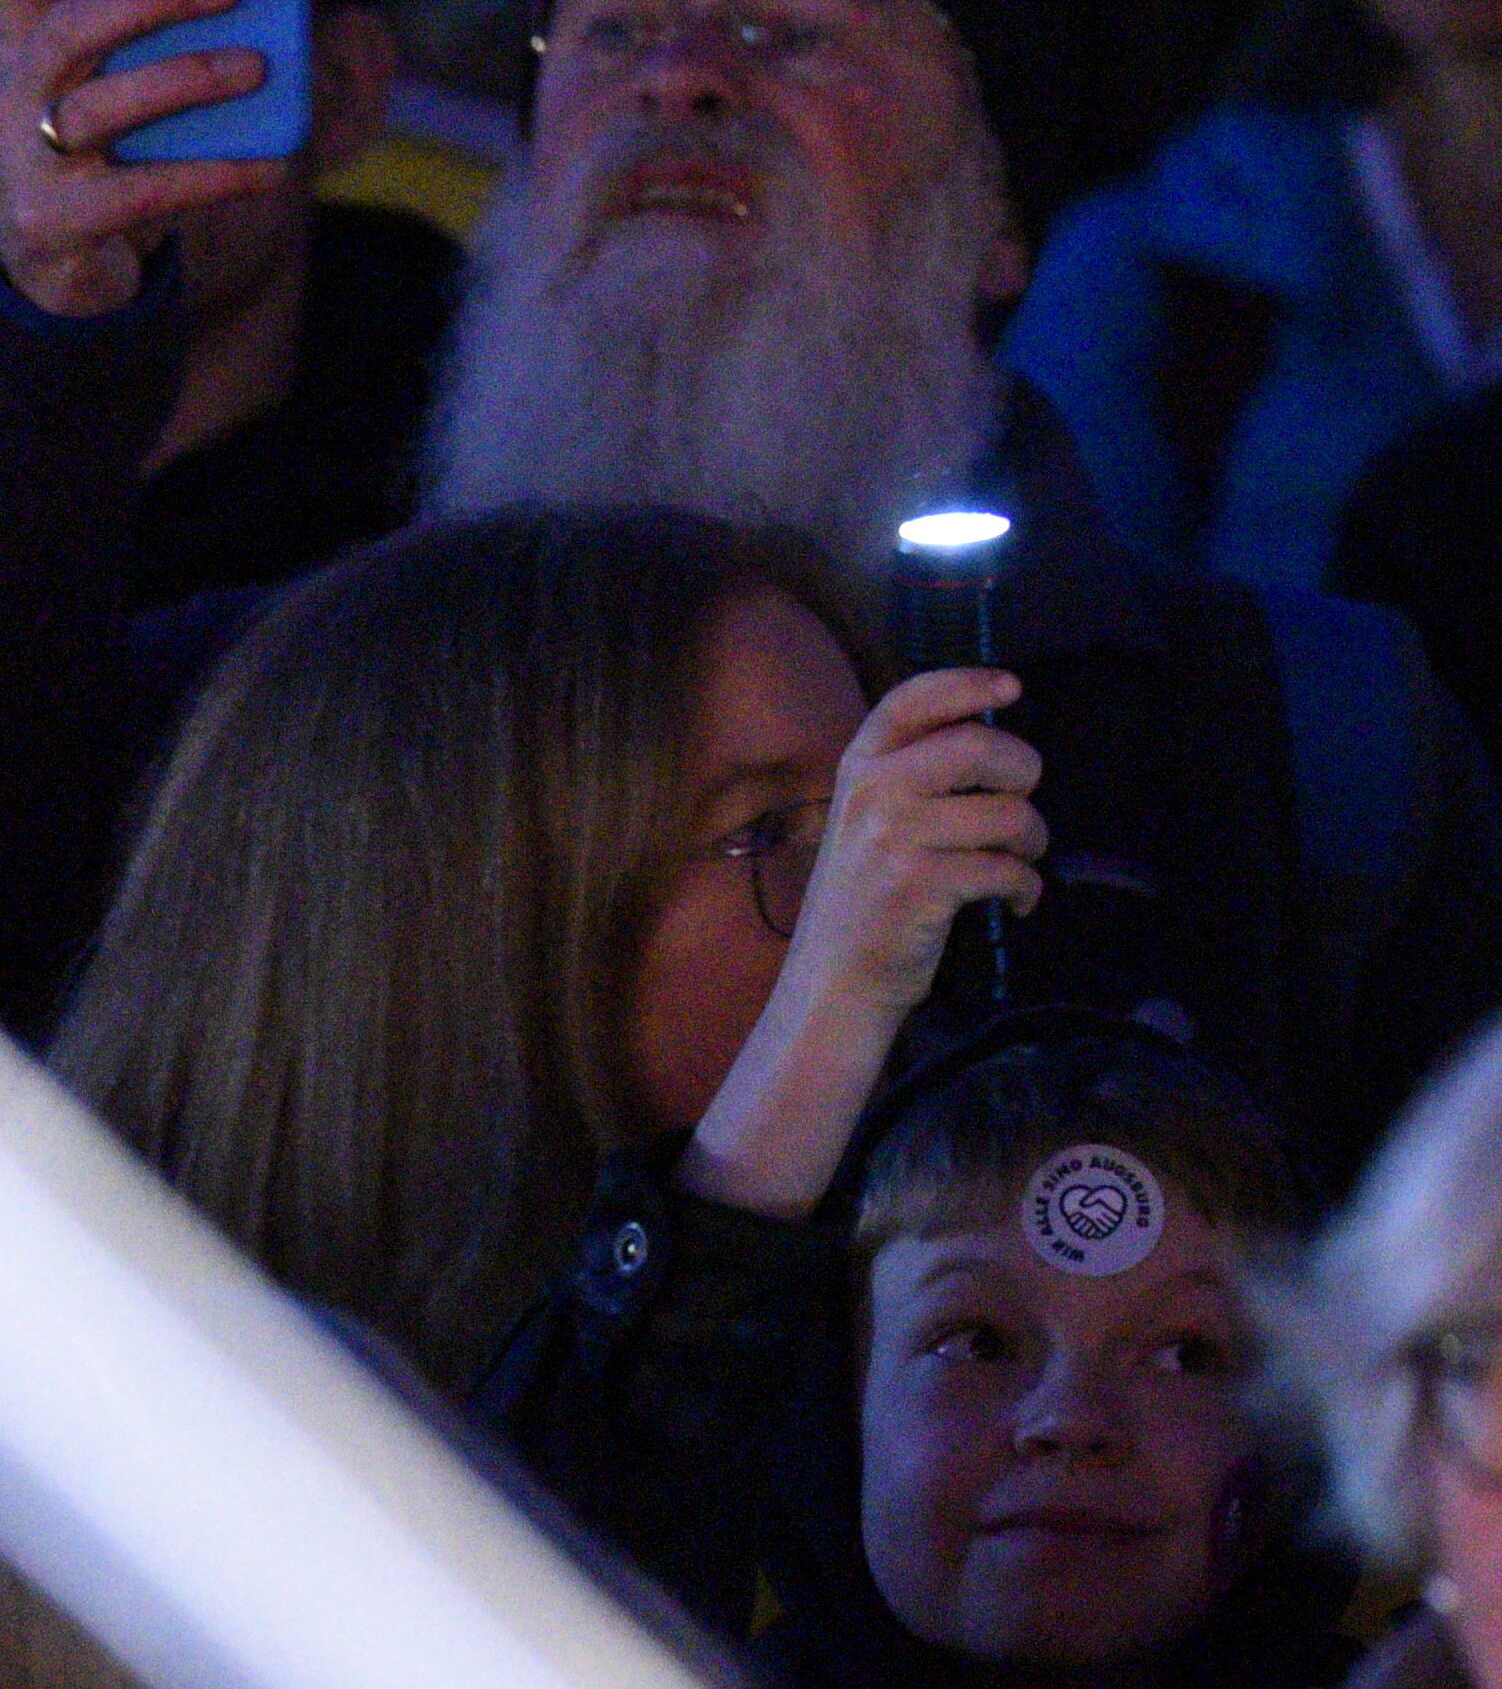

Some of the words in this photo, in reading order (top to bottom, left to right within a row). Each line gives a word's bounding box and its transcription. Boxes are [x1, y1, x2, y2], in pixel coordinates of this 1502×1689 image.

[1043, 1159, 1082, 1191] SIND
[1090, 1156, 1150, 1228] AUGSBURG
[1035, 1196, 1053, 1235] ALLE
[1051, 1239, 1085, 1262] WIR
